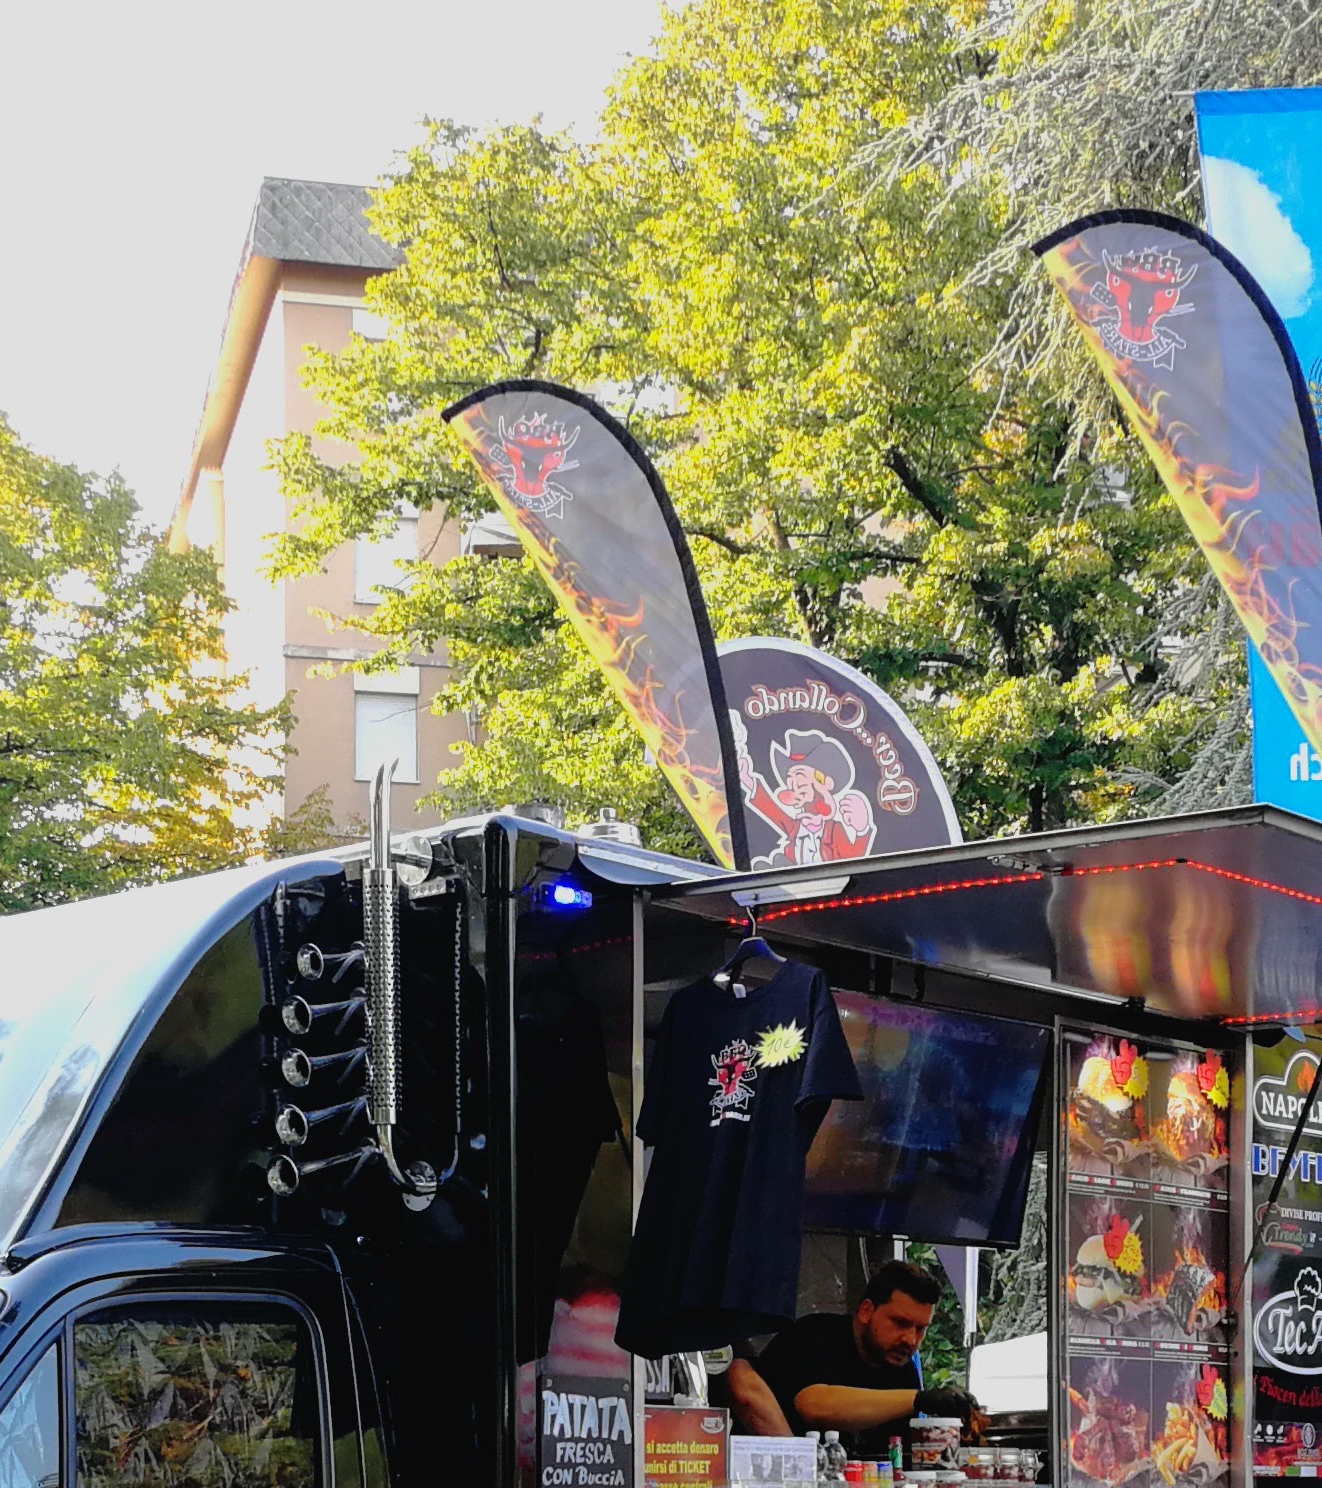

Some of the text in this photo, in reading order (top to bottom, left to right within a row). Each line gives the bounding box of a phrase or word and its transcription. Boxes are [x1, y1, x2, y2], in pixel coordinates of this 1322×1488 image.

[541, 1389, 632, 1445] PATATA
[555, 1442, 616, 1466] FRESCA
[541, 1466, 573, 1487] CON
[678, 1459, 711, 1475] TICKET
